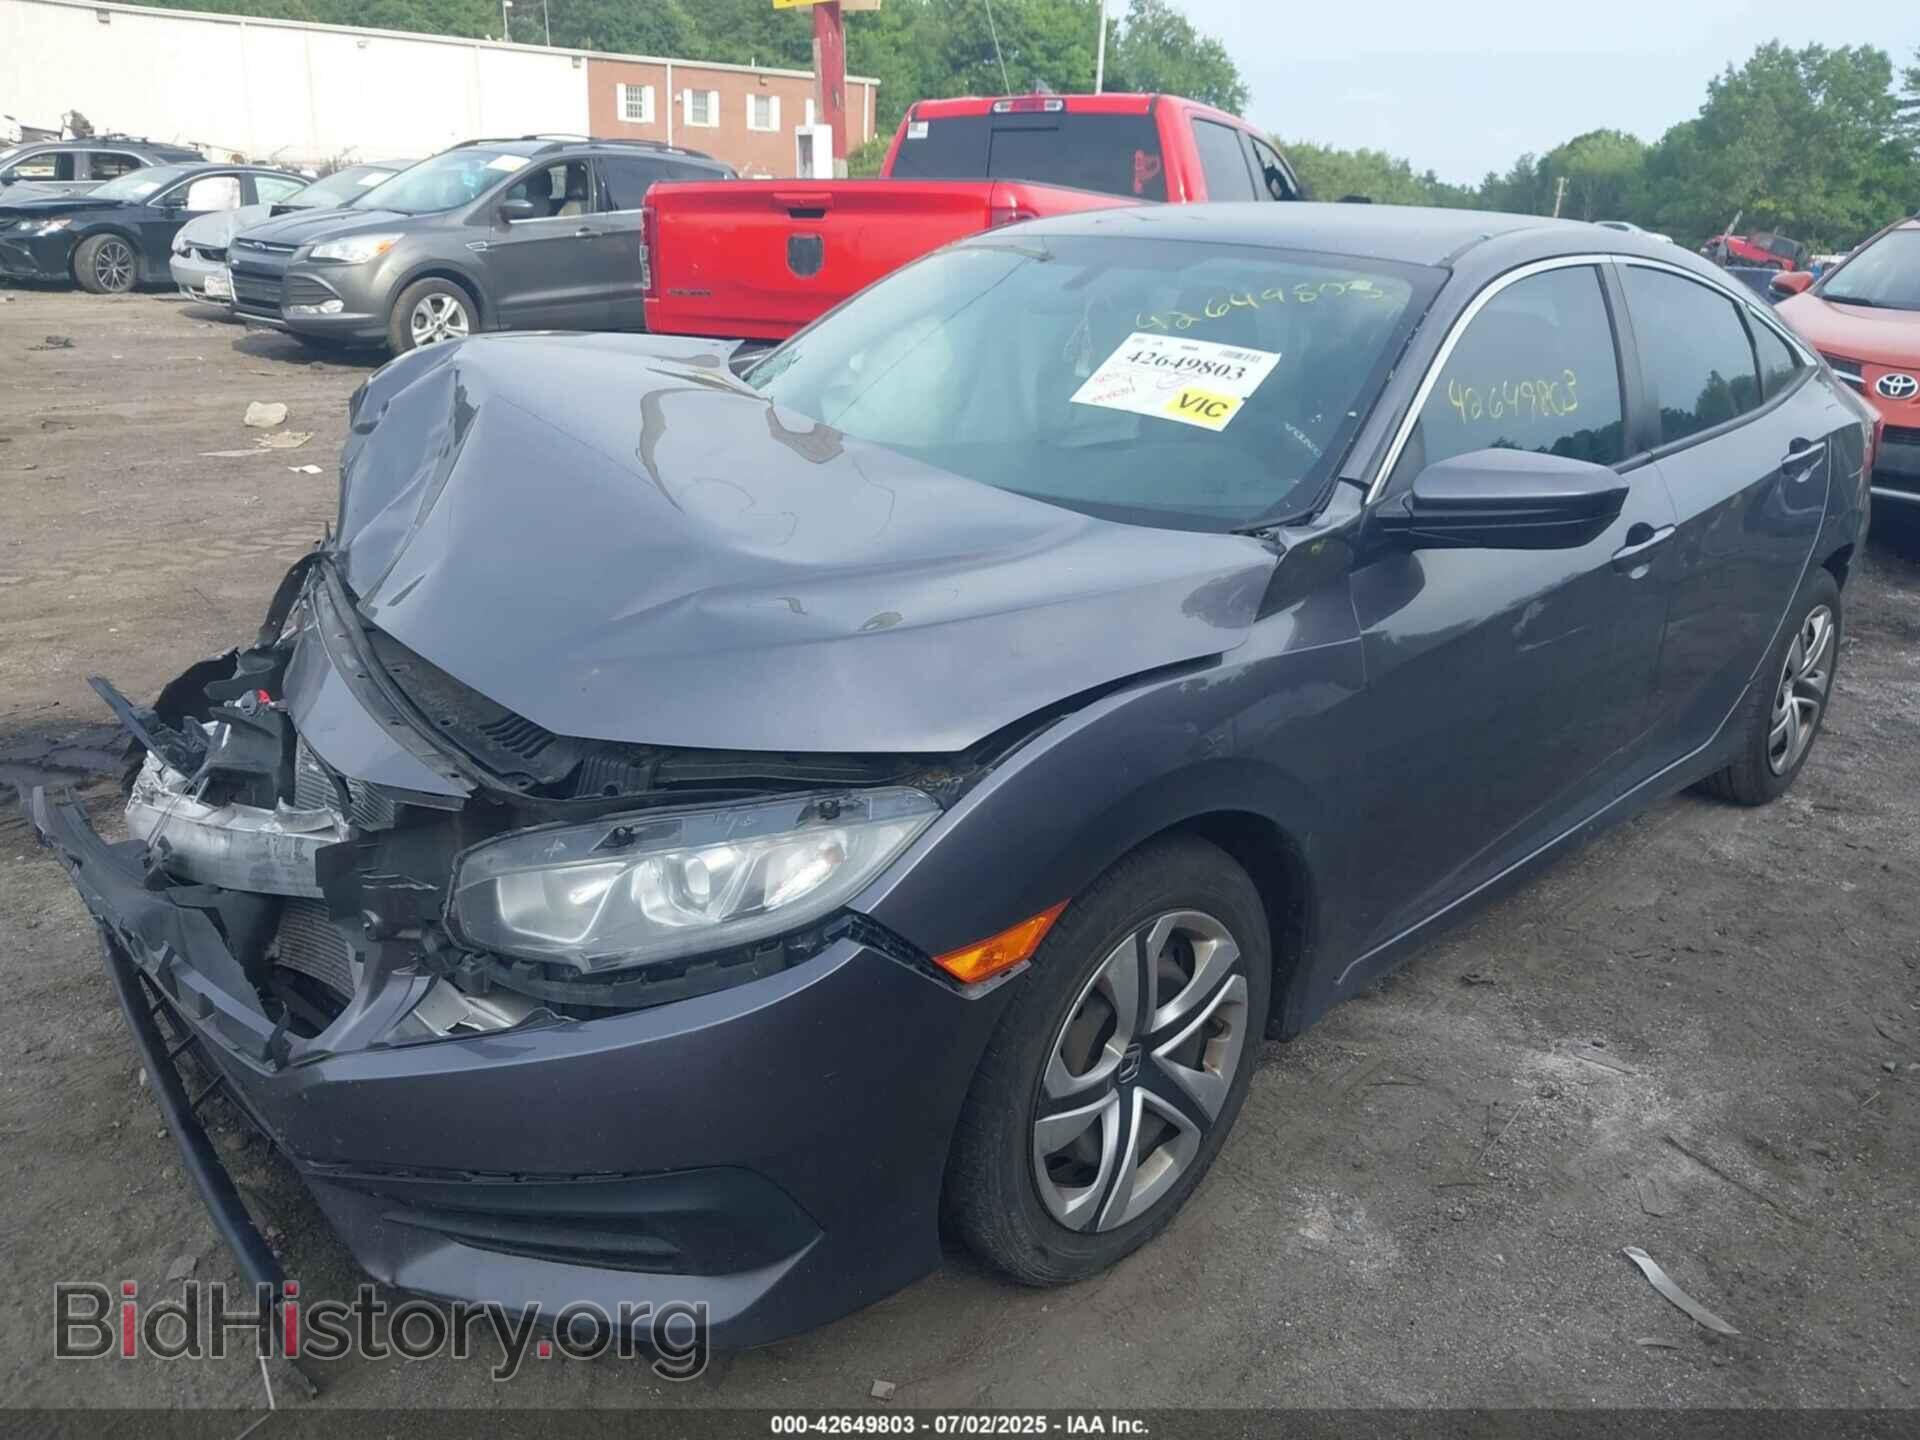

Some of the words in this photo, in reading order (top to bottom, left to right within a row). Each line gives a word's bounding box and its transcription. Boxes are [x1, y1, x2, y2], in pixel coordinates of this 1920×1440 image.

[1127, 350, 1247, 381] 42649803
[1179, 393, 1229, 418] VIC
[1448, 369, 1578, 424] 42649803
